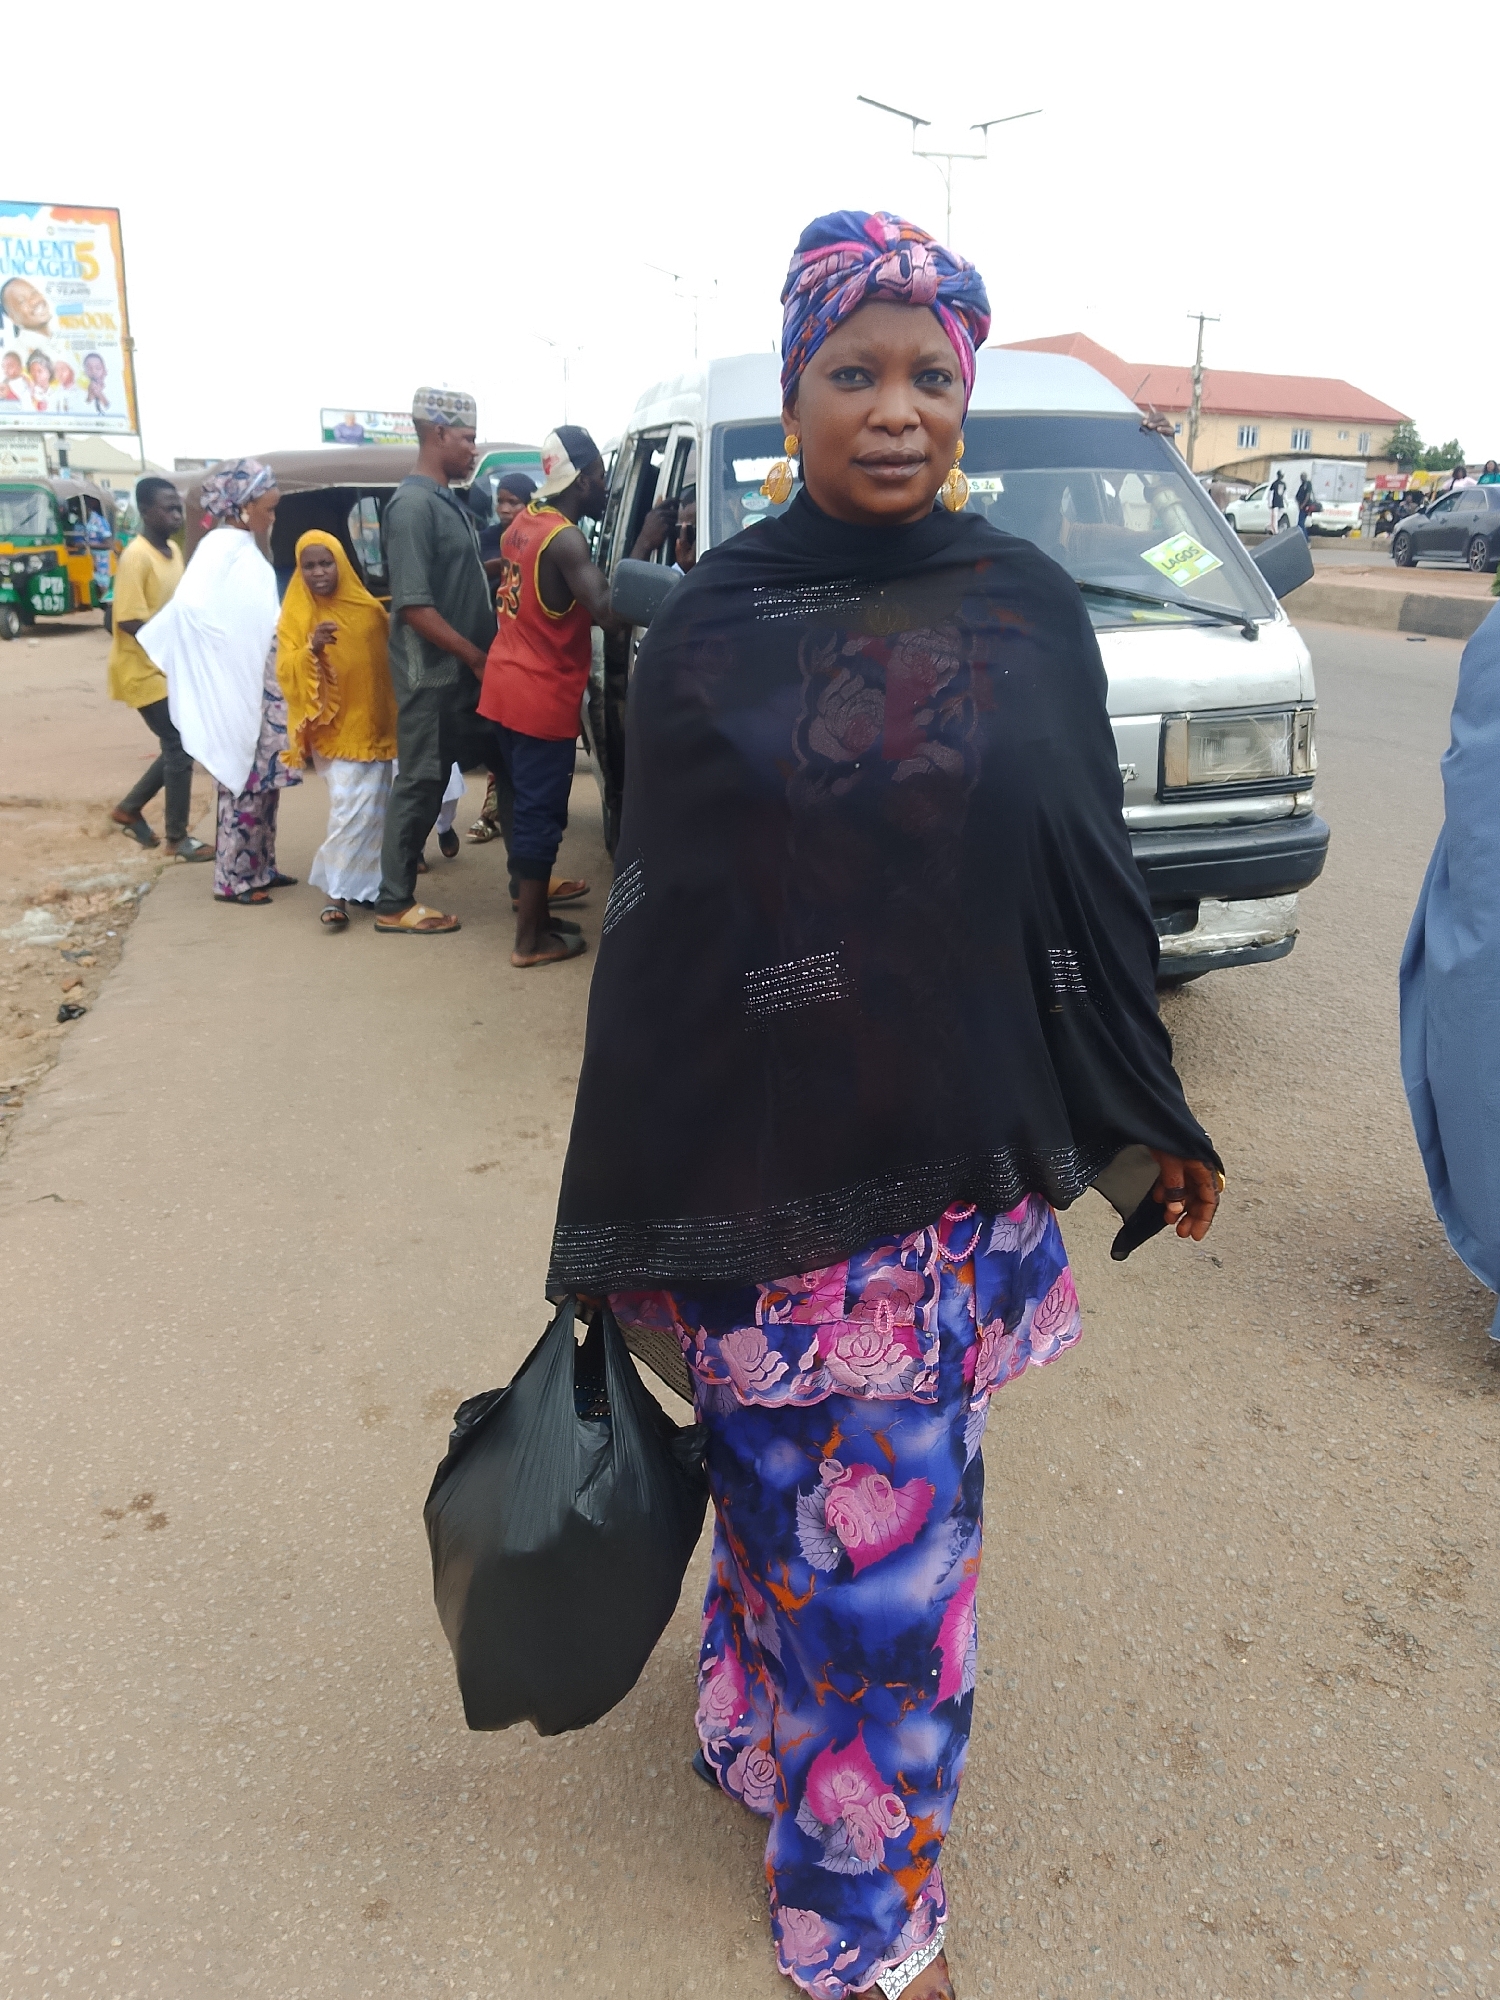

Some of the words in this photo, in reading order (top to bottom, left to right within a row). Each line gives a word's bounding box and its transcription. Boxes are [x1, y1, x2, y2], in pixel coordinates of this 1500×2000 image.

[2, 237, 75, 259] TALENT
[0, 257, 83, 278] UNCAGED
[75, 241, 100, 281] 5
[1161, 546, 1200, 570] LAGOS
